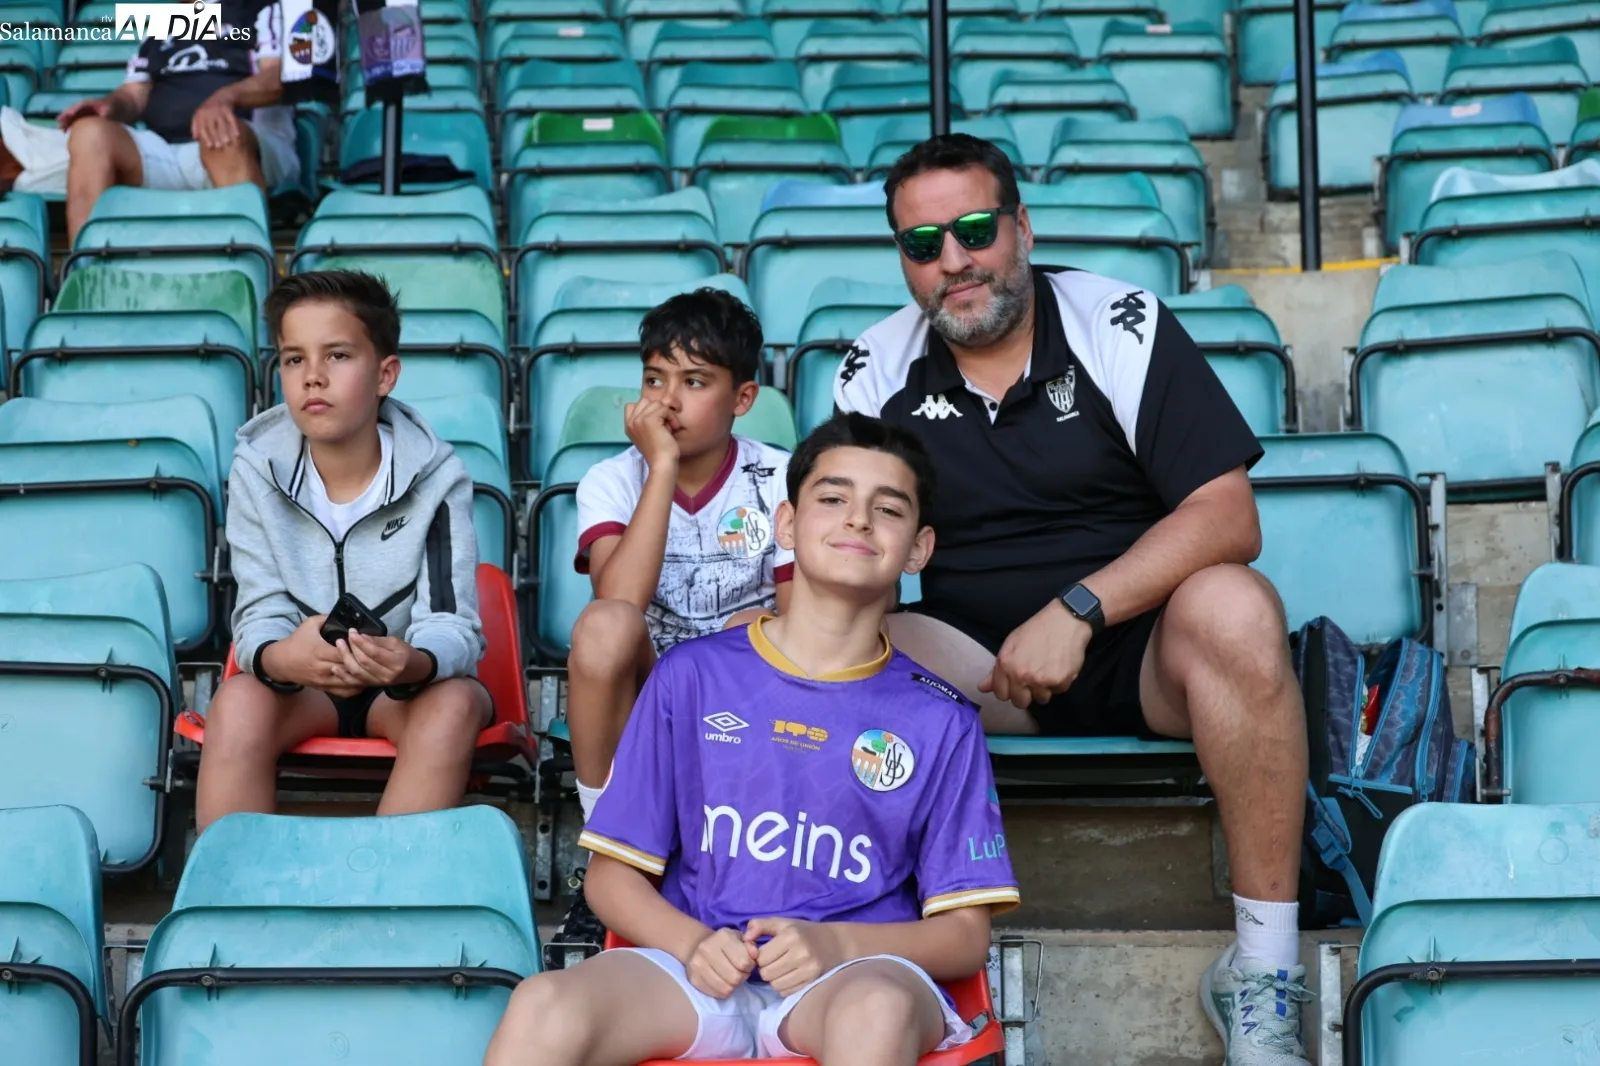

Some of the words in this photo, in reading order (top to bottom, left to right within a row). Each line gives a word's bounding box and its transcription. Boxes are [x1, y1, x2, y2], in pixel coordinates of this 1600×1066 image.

[384, 515, 406, 532] NIKE
[704, 732, 742, 745] umbro
[700, 804, 873, 883] meins
